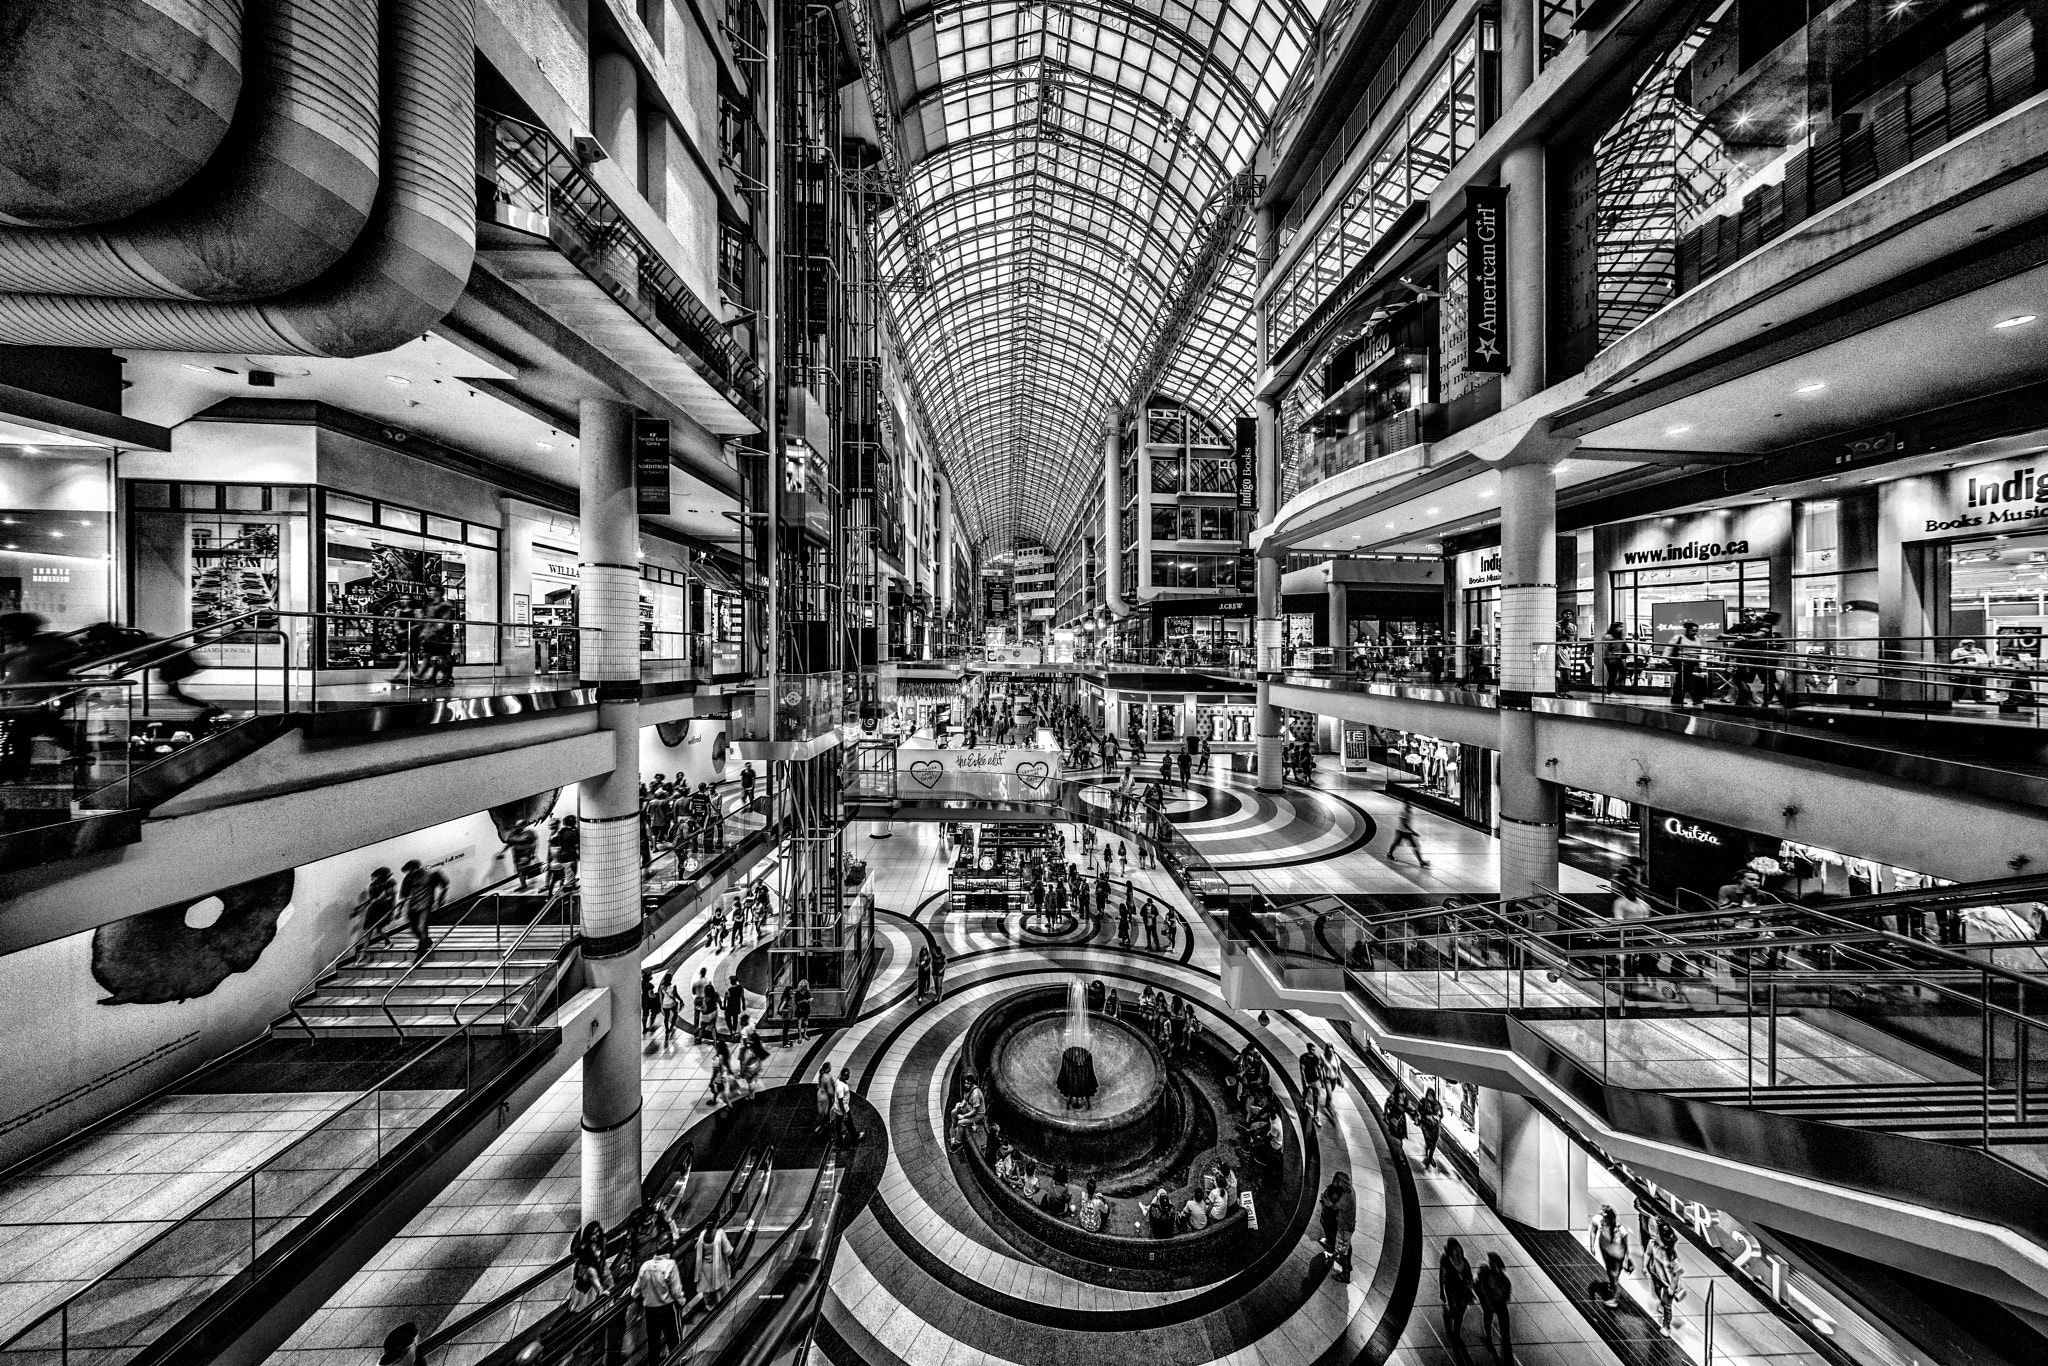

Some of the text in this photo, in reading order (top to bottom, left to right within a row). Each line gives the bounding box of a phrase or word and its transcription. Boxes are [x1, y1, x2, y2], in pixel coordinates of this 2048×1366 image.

[1478, 244, 1497, 335] American
[1298, 264, 1375, 349] IMAGINATION
[1355, 333, 1390, 374] Indigo
[1239, 447, 1254, 507] Indigo Books
[1925, 514, 1983, 533] Books
[1624, 540, 1749, 565] www.indigo.ca
[386, 582, 430, 596] PAELLA
[1469, 576, 1485, 585] Books
[193, 646, 220, 654] ILLIAMS
[1665, 817, 1723, 845] Aritzia
